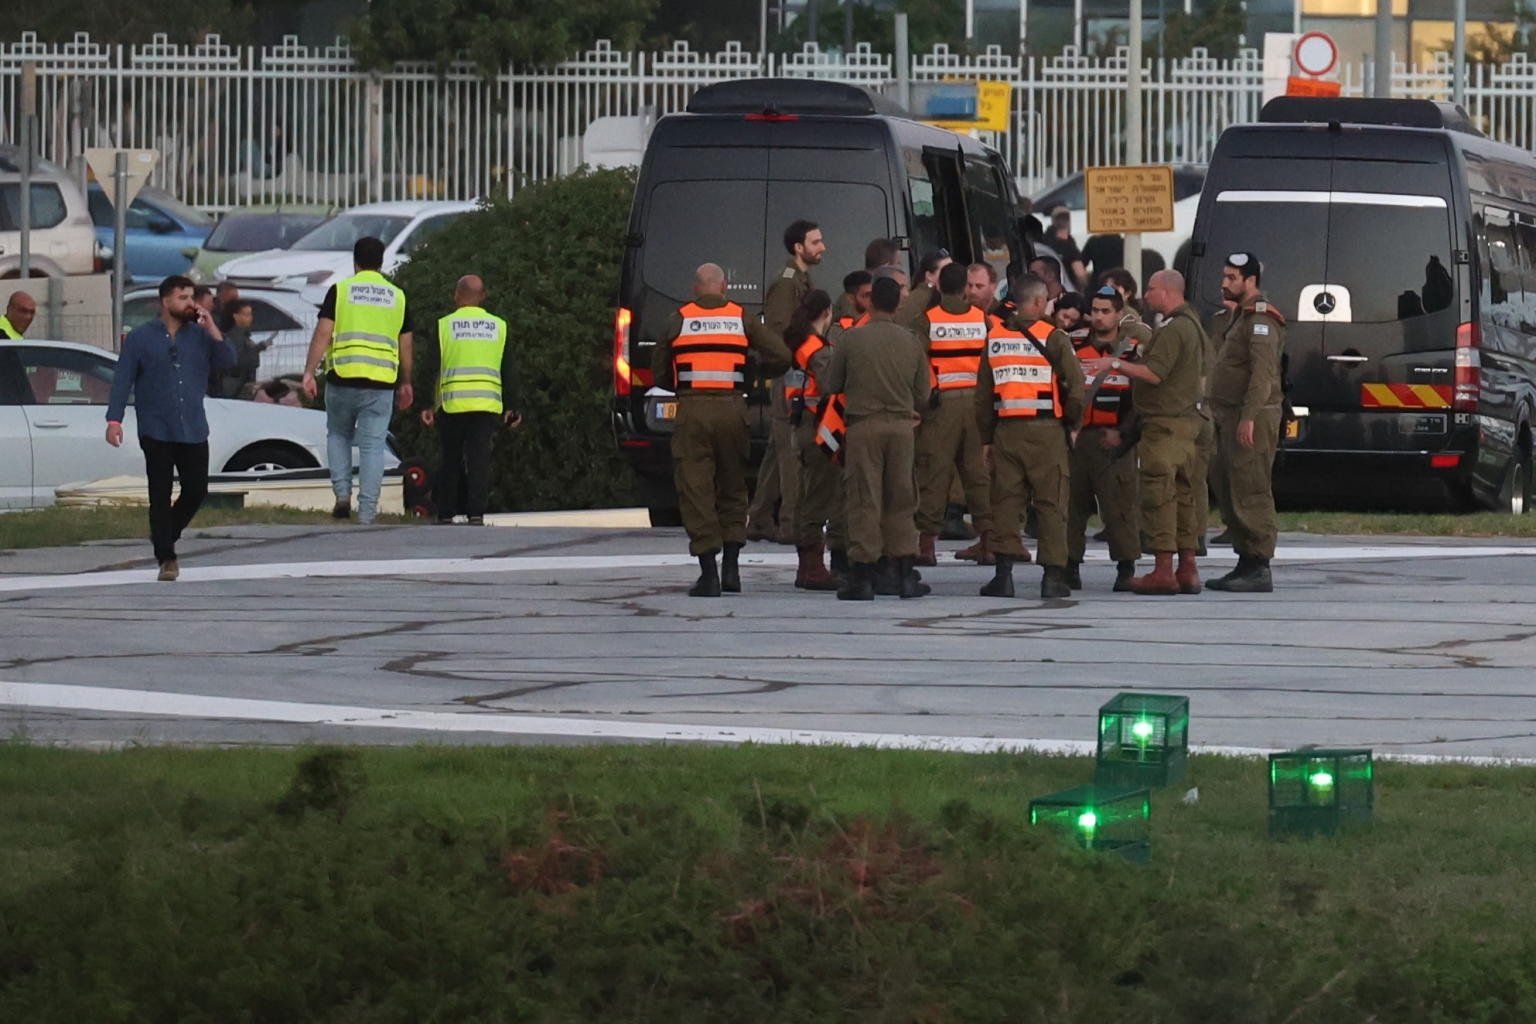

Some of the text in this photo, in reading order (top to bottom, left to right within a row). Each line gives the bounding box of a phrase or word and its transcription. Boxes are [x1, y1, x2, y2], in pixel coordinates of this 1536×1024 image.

[452, 320, 470, 332] תורן
[702, 321, 739, 332] פיקוד העורף
